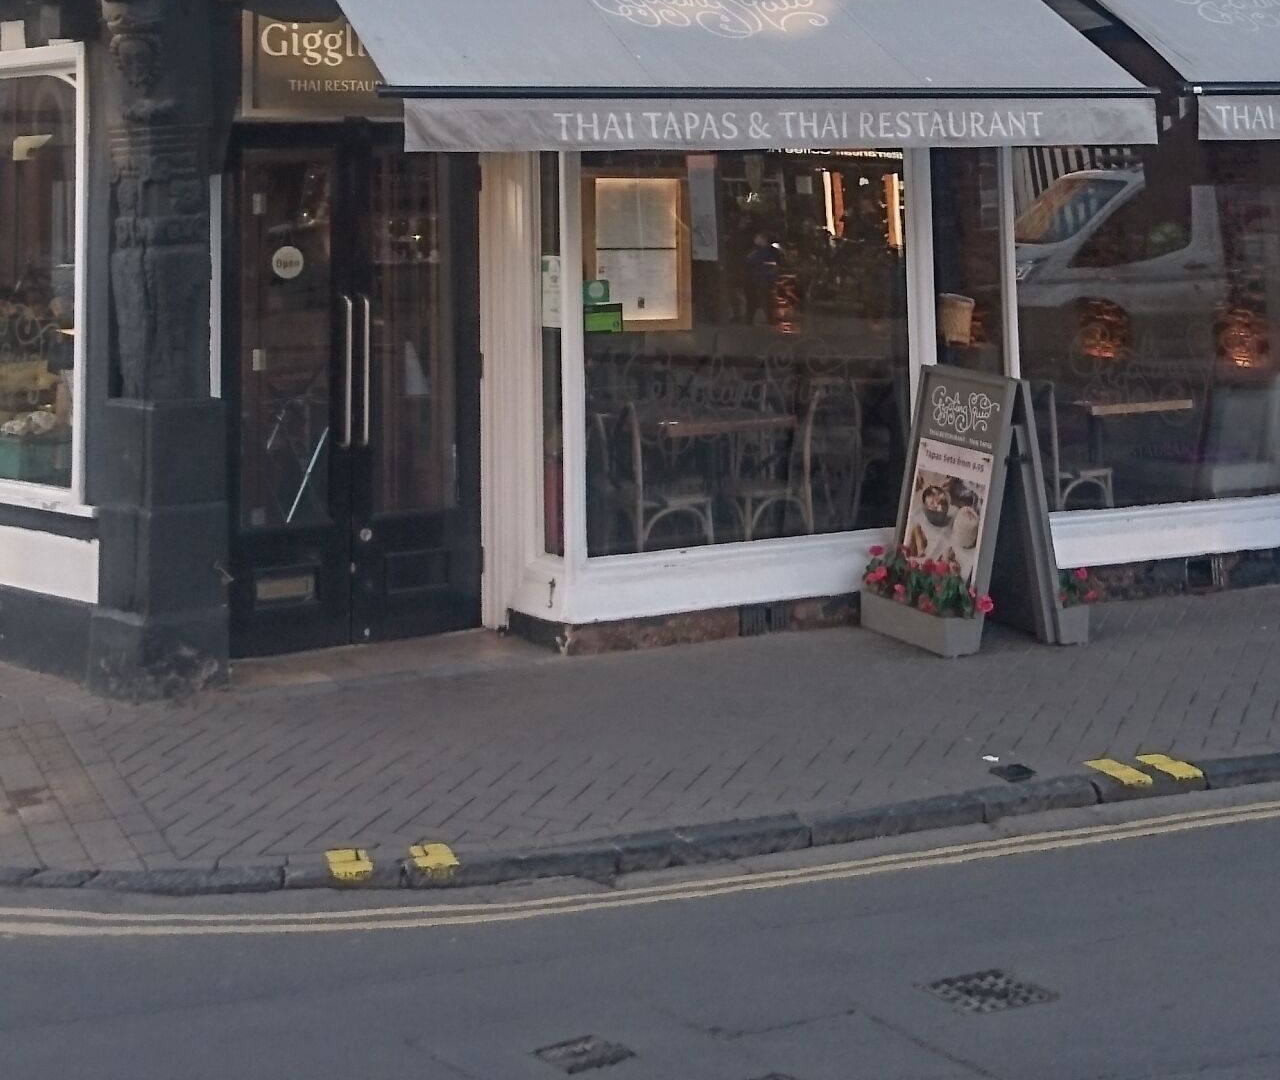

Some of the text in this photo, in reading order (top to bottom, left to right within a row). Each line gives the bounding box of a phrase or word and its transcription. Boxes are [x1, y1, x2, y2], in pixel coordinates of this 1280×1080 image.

[289, 79, 321, 92] THAI
[553, 111, 1044, 142] THAI TAPAS & THAI RESTAURANT
[1218, 105, 1274, 131] THAI
